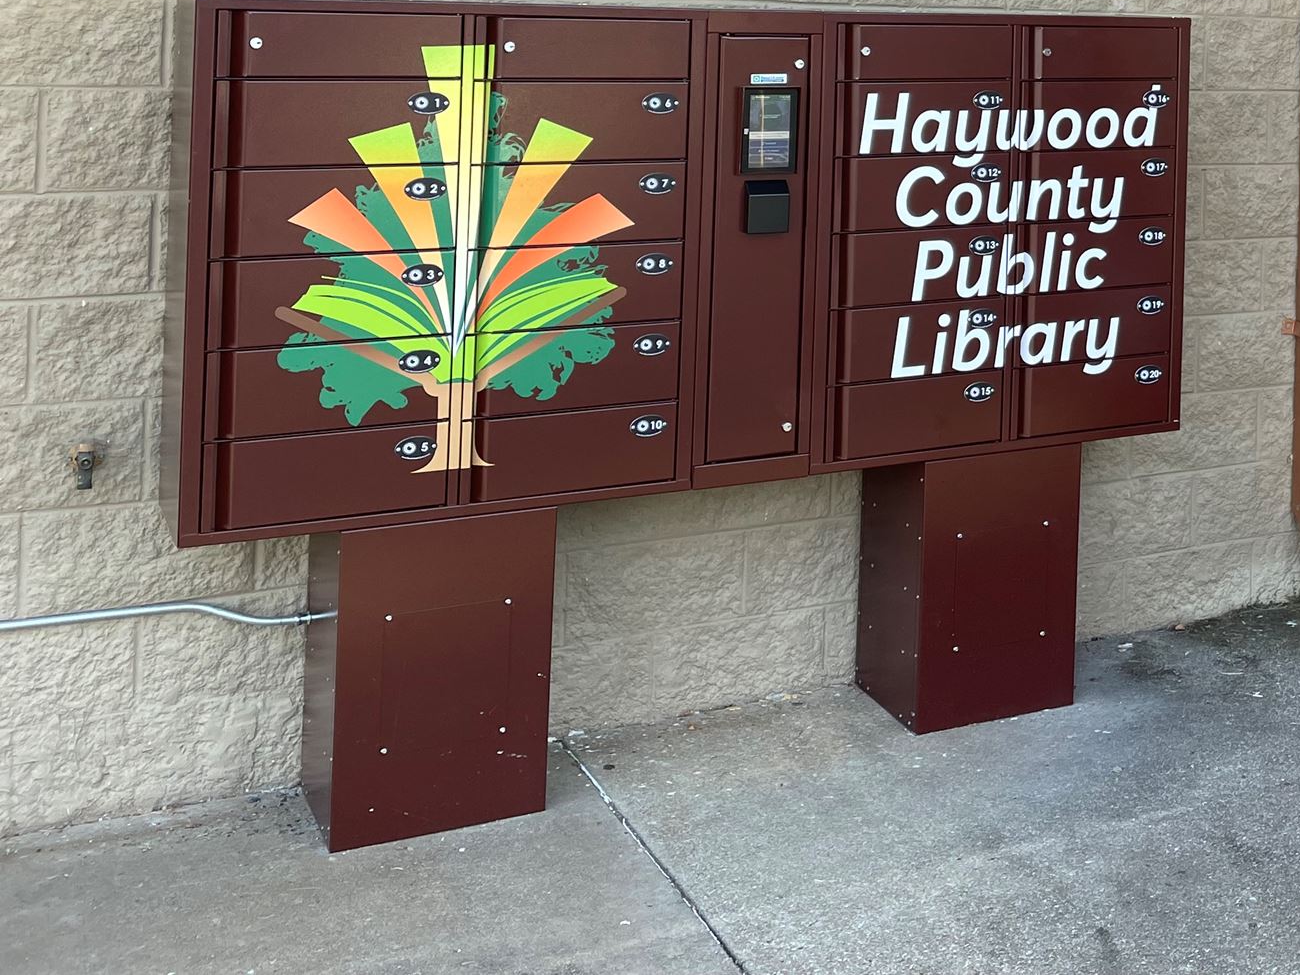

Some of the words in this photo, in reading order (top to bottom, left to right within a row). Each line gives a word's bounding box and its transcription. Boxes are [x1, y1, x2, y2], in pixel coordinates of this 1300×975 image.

[665, 99, 671, 107] 6
[991, 96, 999, 104] 11
[1158, 95, 1167, 103] 16
[859, 84, 1161, 167] Haywood
[1156, 163, 1165, 171] 17
[988, 169, 998, 177] 12
[662, 179, 668, 187] 7
[430, 185, 437, 193] 2
[895, 165, 1124, 233] County
[1154, 232, 1163, 240] 18
[986, 241, 995, 249] 13
[659, 260, 665, 268] 8
[911, 230, 1107, 302] Public
[427, 270, 435, 279] 3
[983, 314, 993, 322] 14
[656, 340, 662, 348] 9
[890, 309, 1120, 378] Library
[424, 356, 431, 364] 4
[1150, 370, 1159, 378] 20
[651, 421, 662, 429] 10
[421, 443, 428, 451] 5
